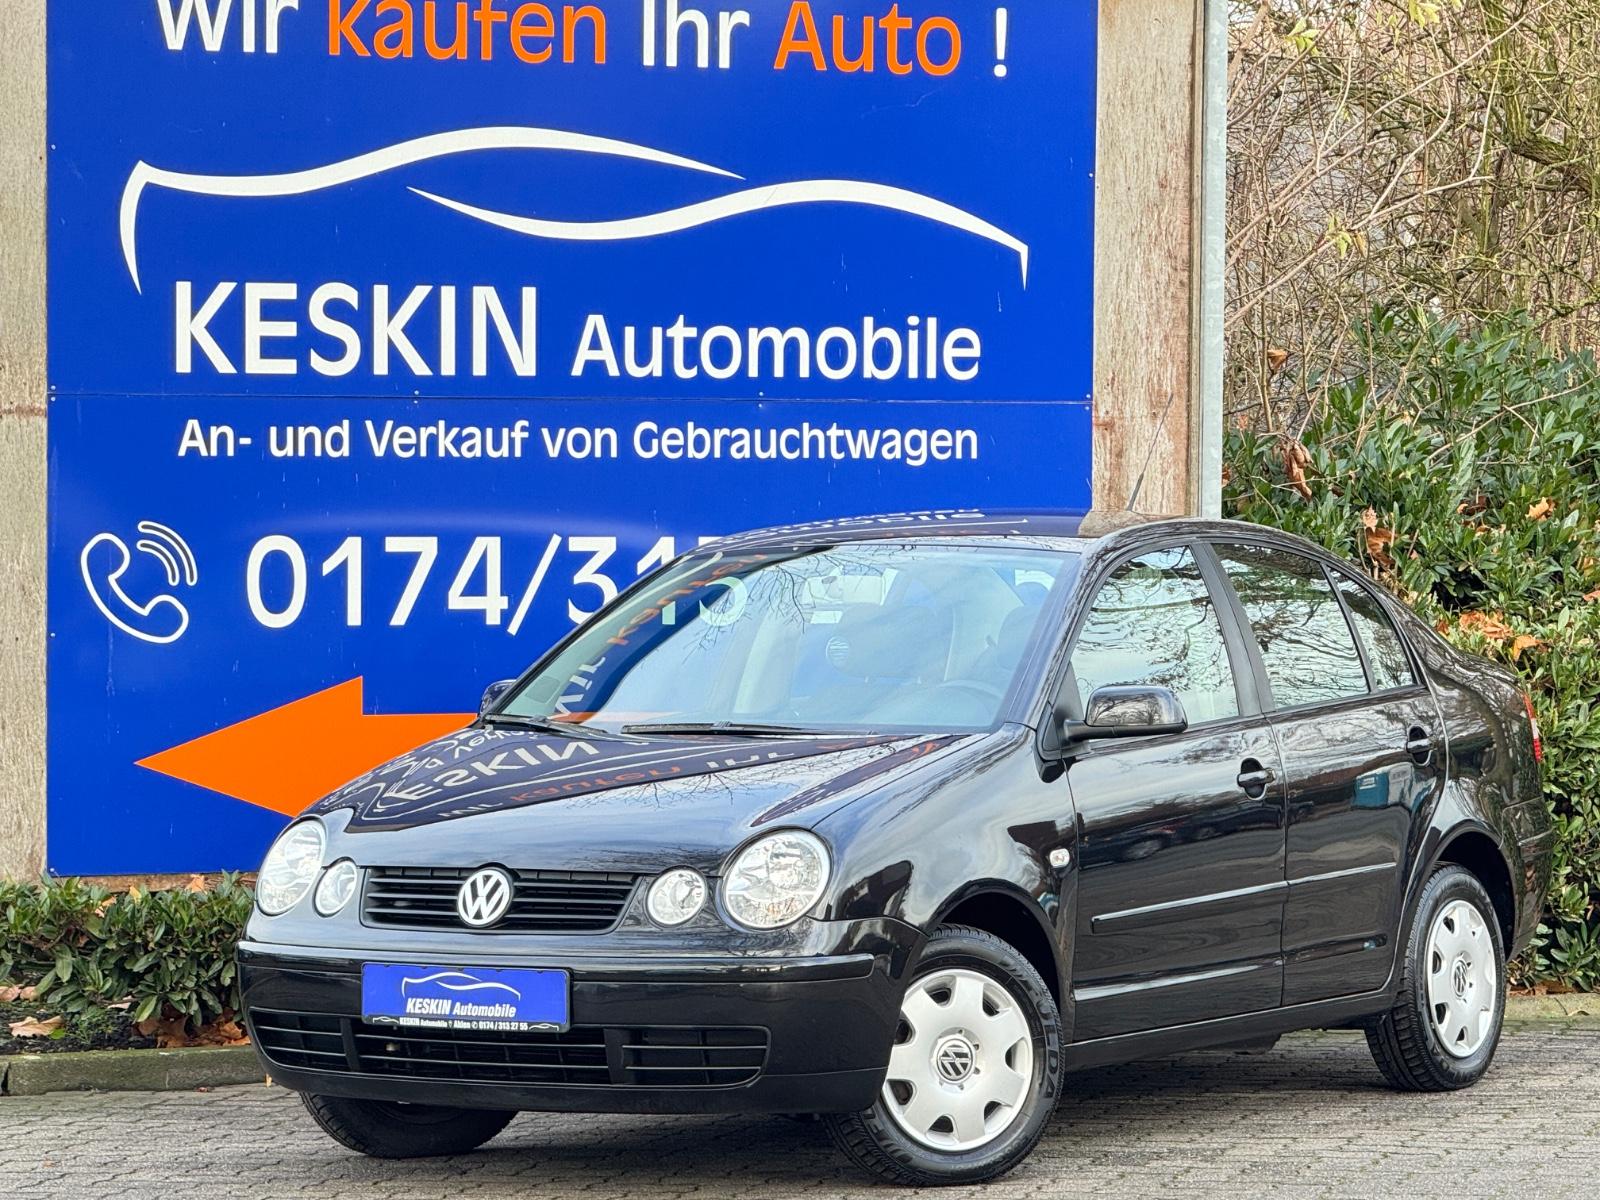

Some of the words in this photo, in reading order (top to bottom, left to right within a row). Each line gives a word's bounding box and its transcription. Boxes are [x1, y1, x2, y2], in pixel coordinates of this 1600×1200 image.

[157, 0, 300, 54] Wir
[328, 0, 607, 65] kaufen
[642, 0, 751, 70] Ihr
[773, 0, 962, 77] Auto
[993, 7, 1008, 78] !
[175, 280, 537, 377] KESKIN
[570, 314, 981, 381] Automobile
[177, 418, 252, 457] An-
[269, 419, 350, 458] und
[364, 419, 530, 459] Verkauf
[541, 426, 618, 459] von
[633, 420, 978, 467] Gebrauchtwagen
[406, 997, 452, 1015] KESKIN
[452, 1002, 517, 1018] Automobile
